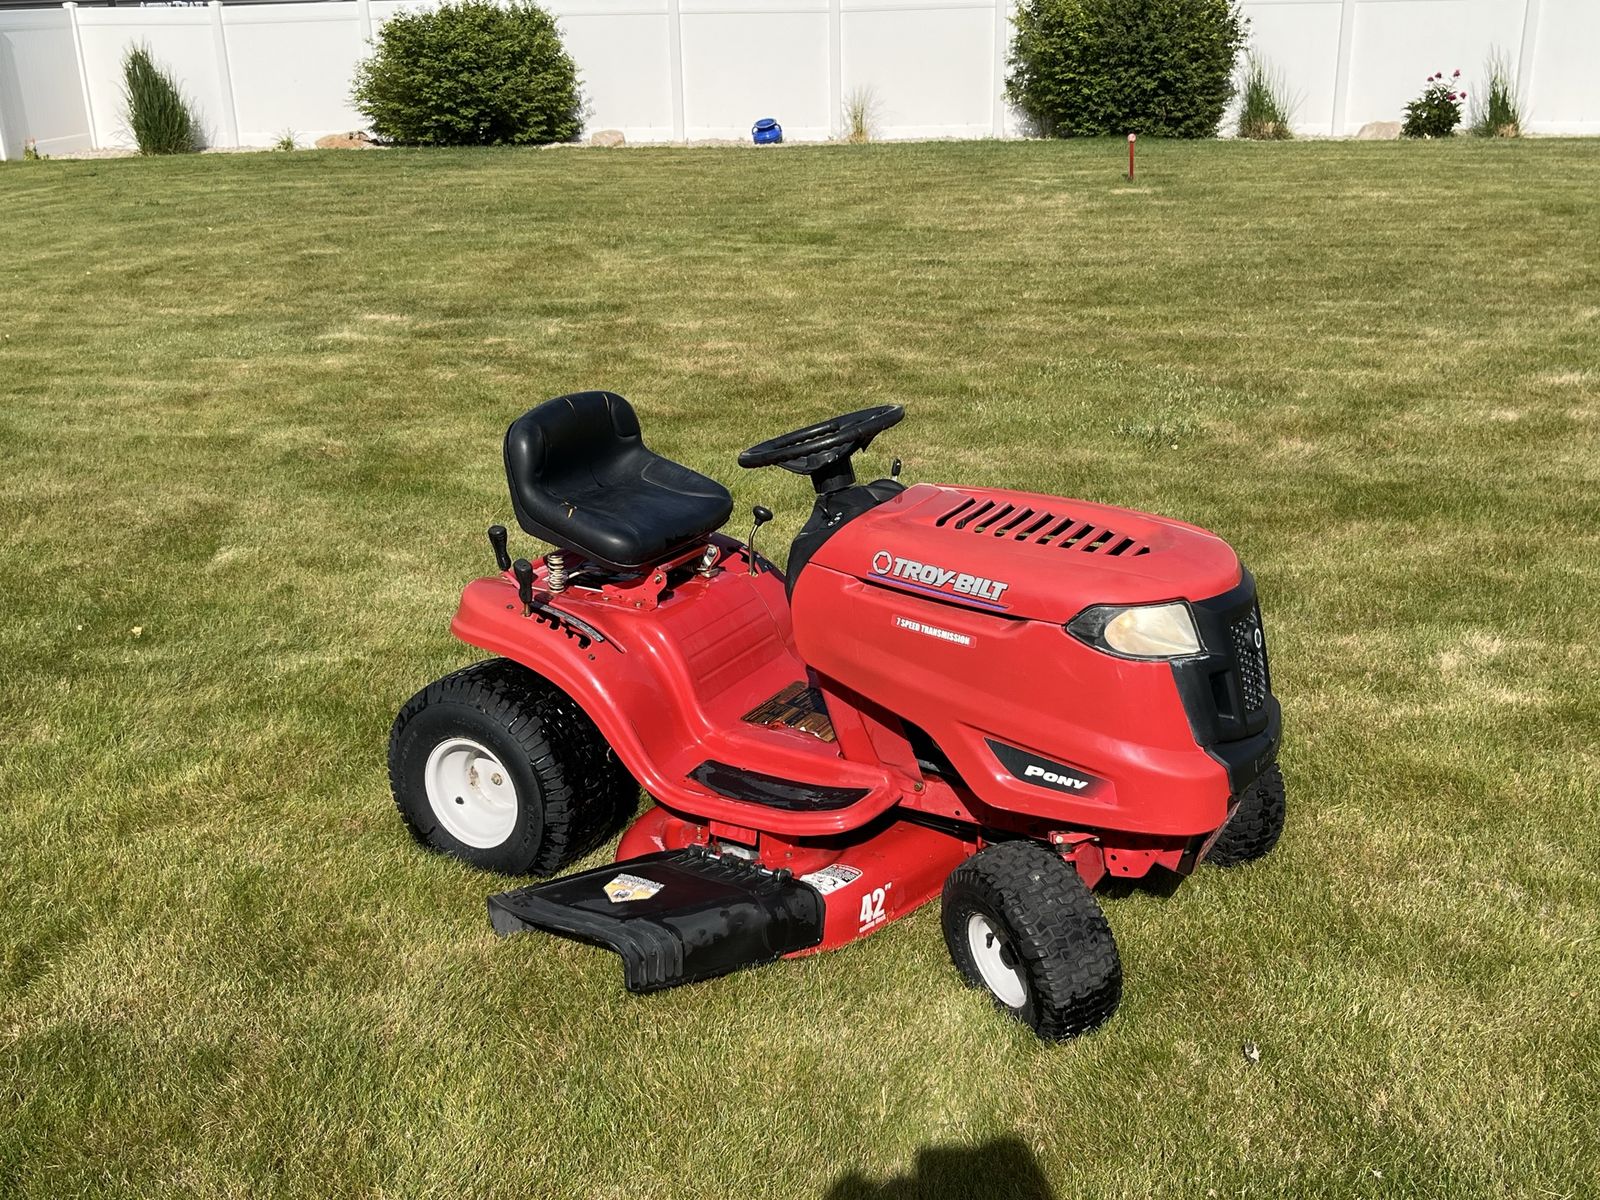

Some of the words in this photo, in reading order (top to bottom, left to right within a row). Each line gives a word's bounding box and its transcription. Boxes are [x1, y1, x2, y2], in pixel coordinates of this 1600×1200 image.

[893, 556, 1009, 601] TROY-BILT
[896, 617, 902, 626] 7
[900, 618, 920, 632] SPEED
[921, 624, 970, 645] TRANSMISSION
[1024, 765, 1089, 790] PONY
